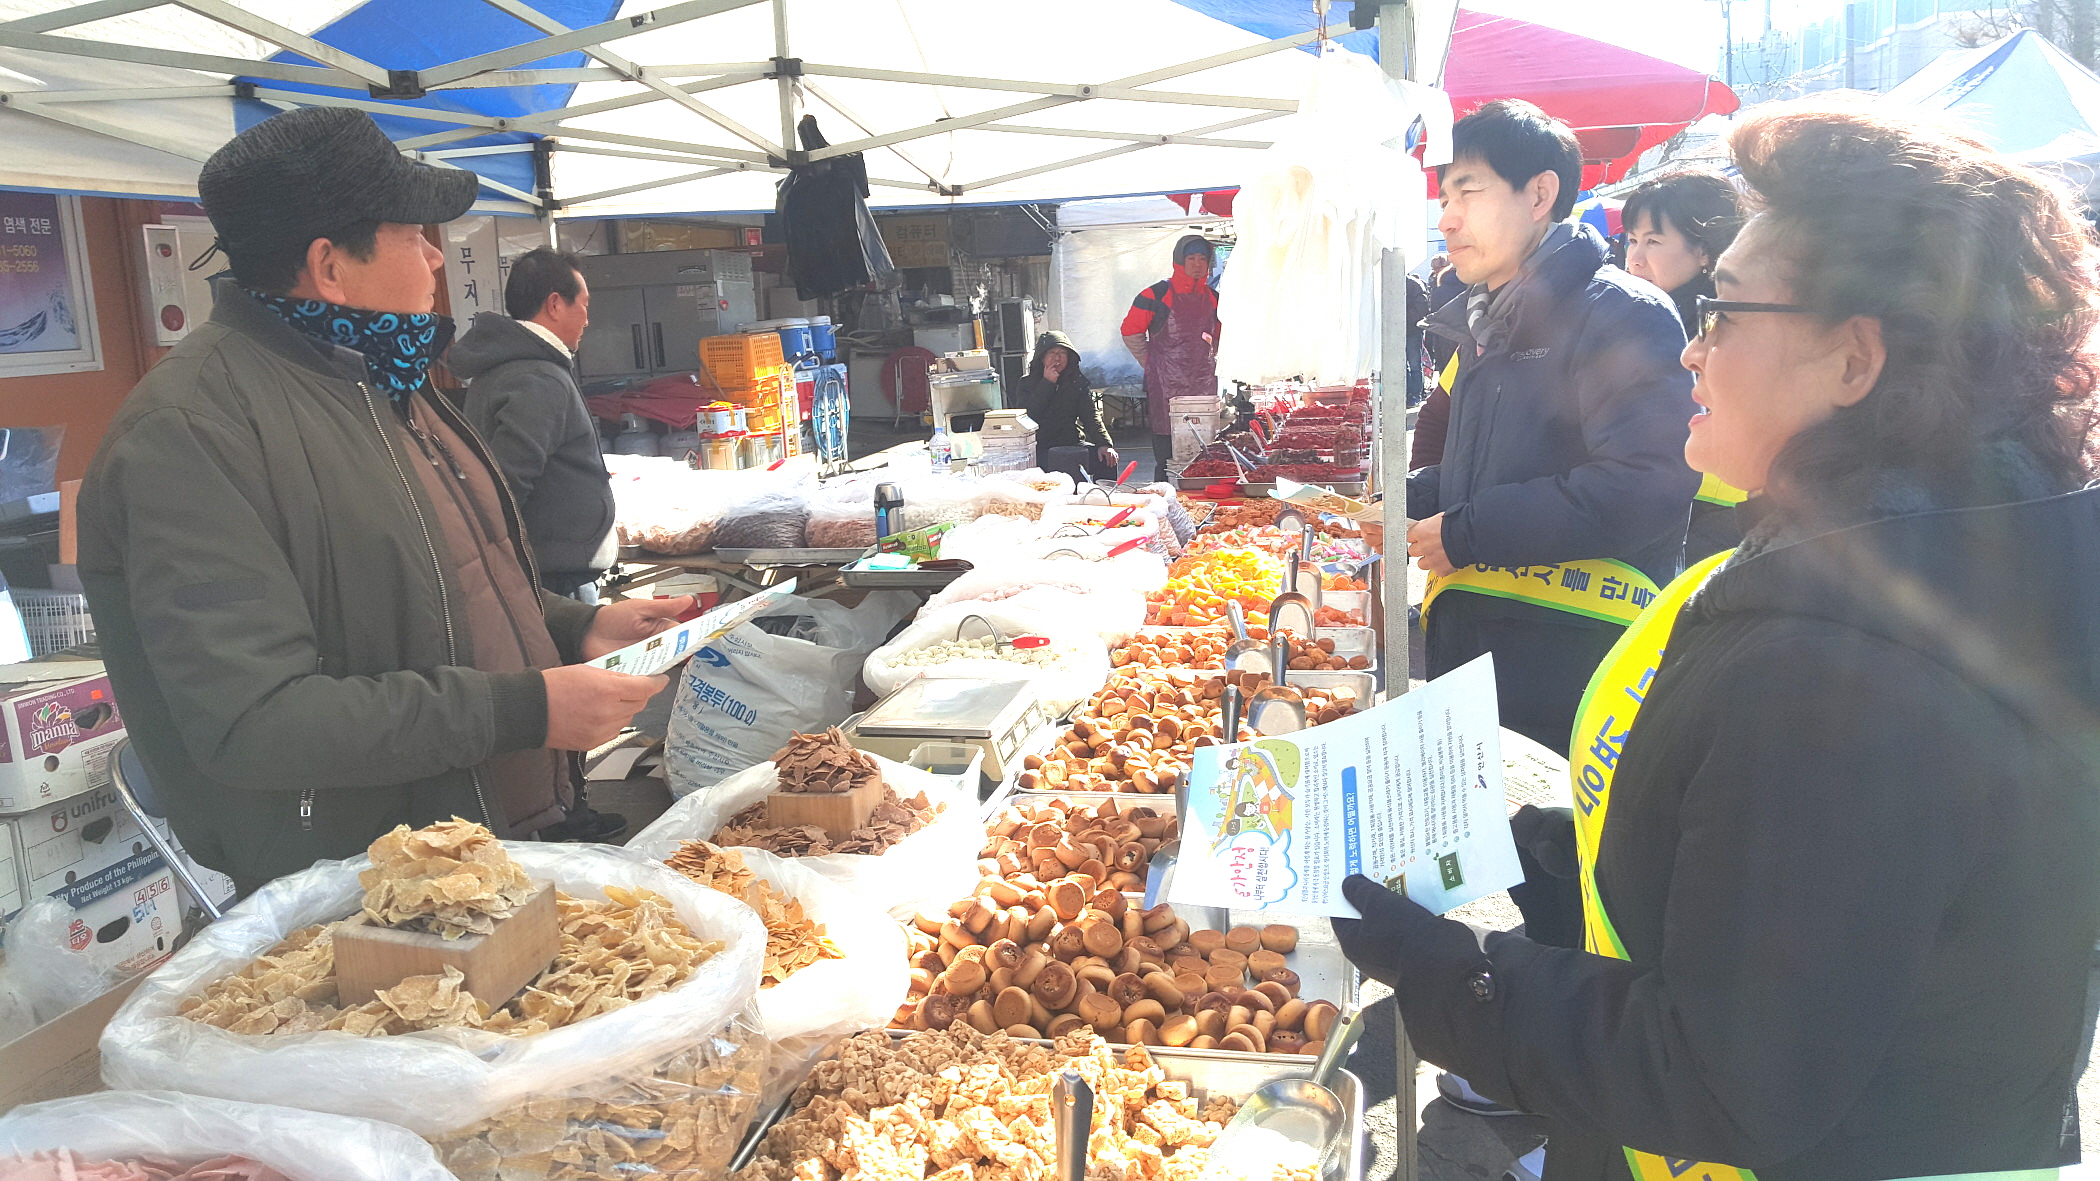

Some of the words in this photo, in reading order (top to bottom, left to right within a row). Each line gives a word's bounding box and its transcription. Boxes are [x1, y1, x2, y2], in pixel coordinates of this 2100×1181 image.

[3, 216, 27, 234] 염색
[30, 217, 52, 235] 전문
[30, 719, 80, 750] manna
[1475, 741, 1485, 772] 안산시
[1346, 792, 1357, 826] 어떨까요?
[1348, 826, 1358, 858] 노력하면
[70, 877, 104, 899] Produce
[104, 871, 114, 883] of
[113, 865, 127, 877] the
[80, 892, 91, 904] Net
[91, 882, 113, 899] Weight
